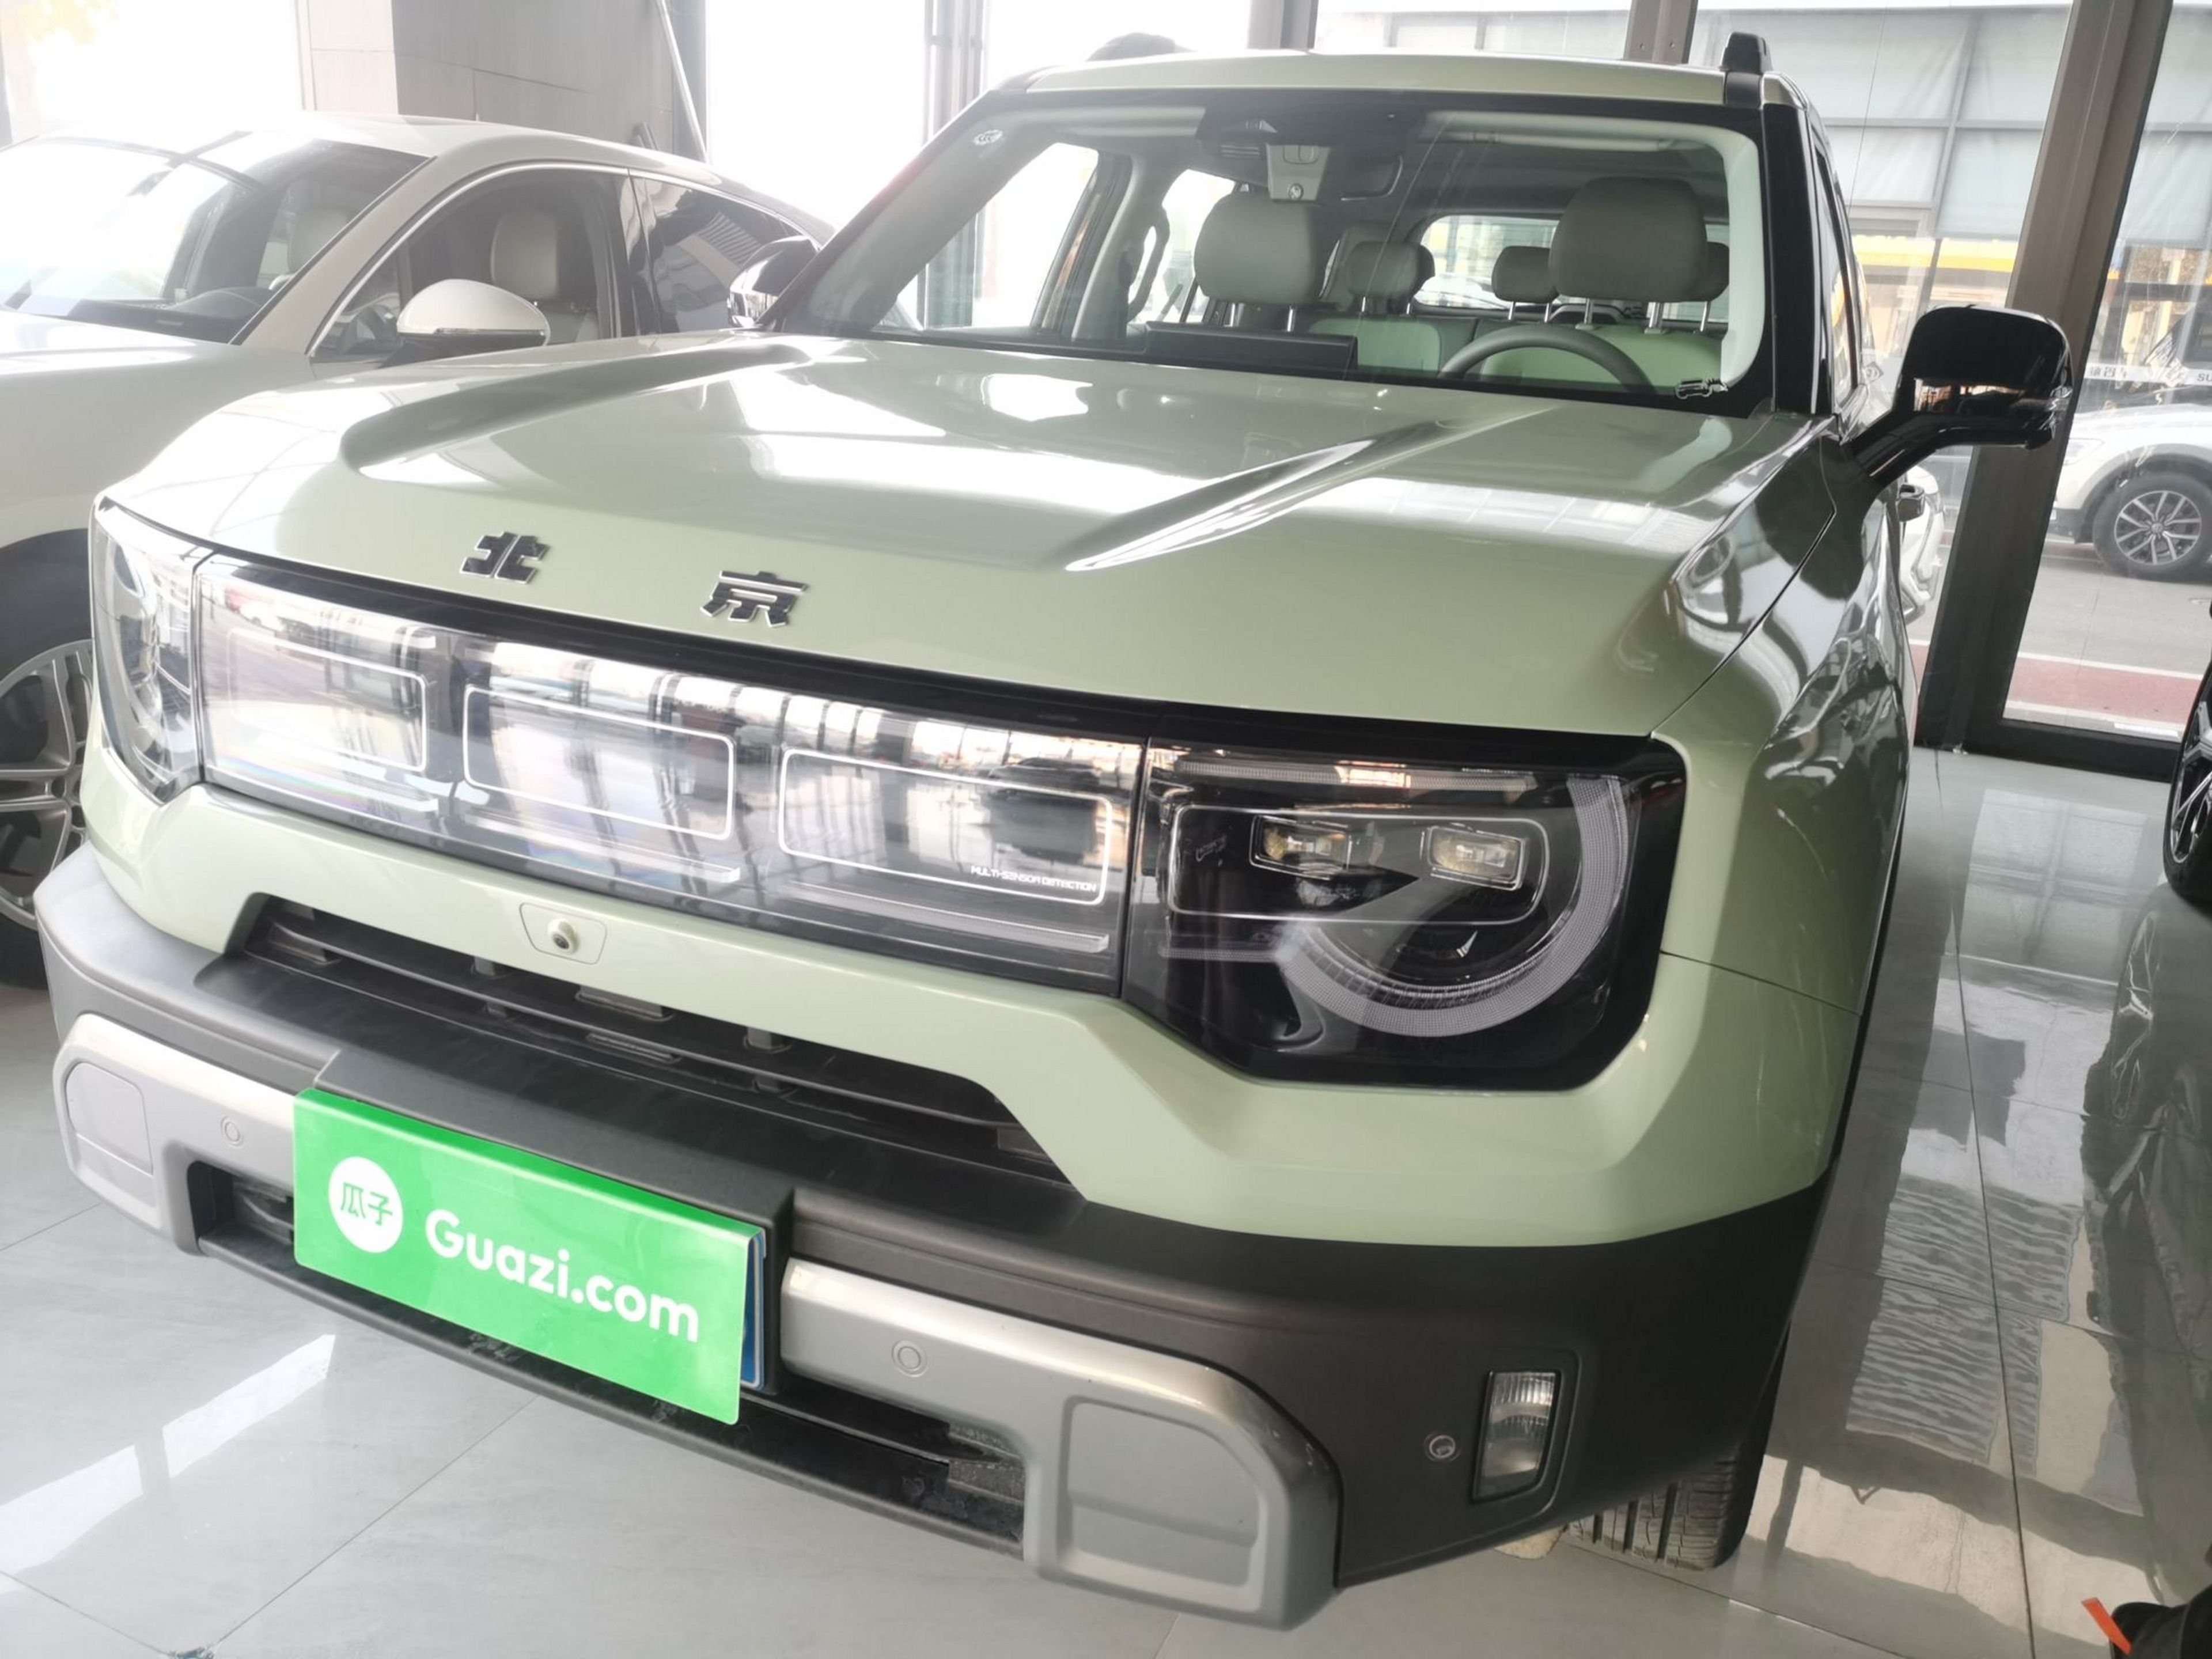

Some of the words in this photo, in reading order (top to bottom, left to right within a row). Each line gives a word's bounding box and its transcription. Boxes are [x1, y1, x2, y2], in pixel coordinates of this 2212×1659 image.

[460, 531, 808, 627] 北京
[971, 865, 1041, 884] MULTI-SENSOR
[1041, 877, 1097, 892] DETECTION
[340, 1181, 393, 1226] 瓜子
[425, 1209, 699, 1343] Guazi.com
